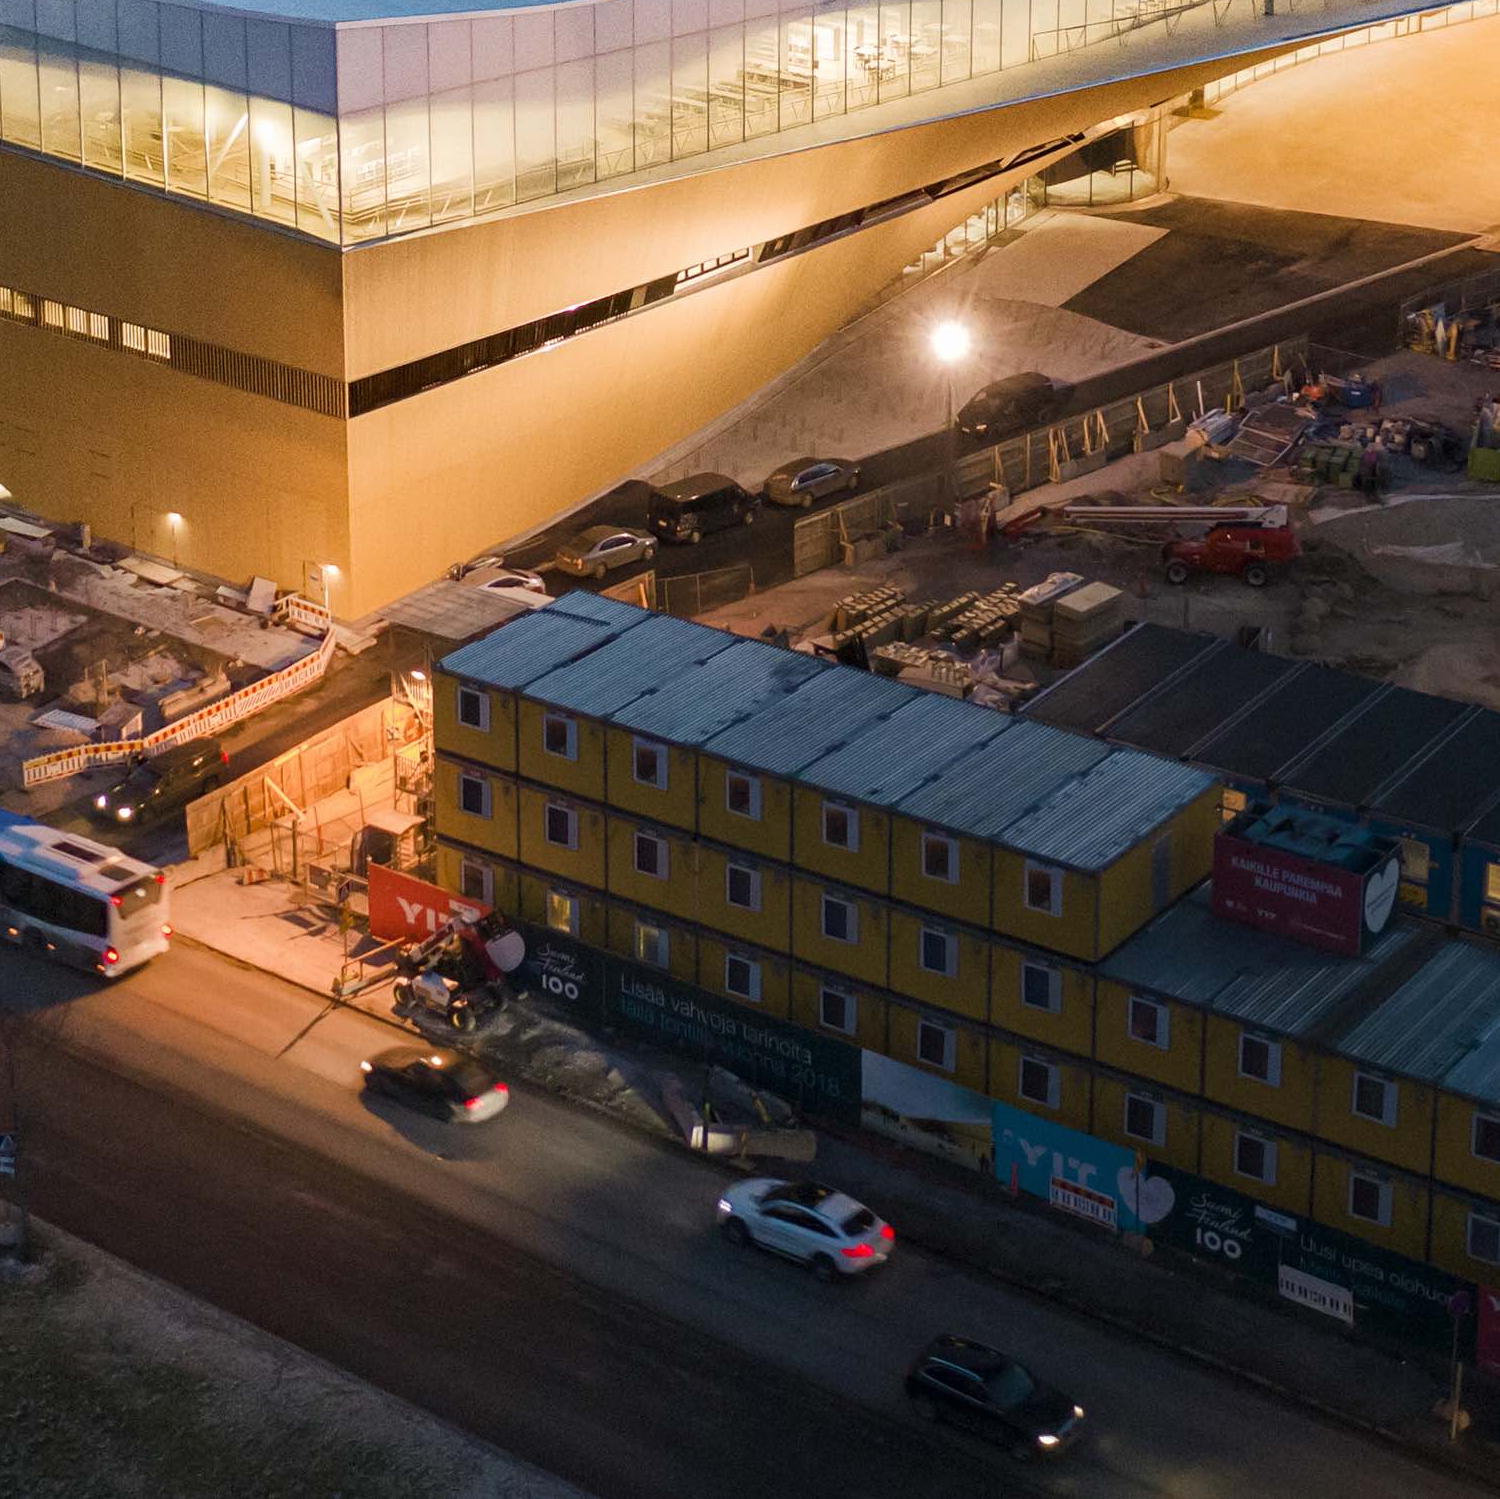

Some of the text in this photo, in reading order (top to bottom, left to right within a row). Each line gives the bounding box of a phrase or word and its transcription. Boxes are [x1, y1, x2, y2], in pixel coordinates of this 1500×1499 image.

[1231, 855, 1343, 899] KAIKILLE PAREMPAA
[1253, 876, 1318, 905] KAUPUNKIA
[541, 973, 580, 1001] 100
[742, 1023, 812, 1066] tarinoita
[791, 1062, 841, 1098] 2018
[1018, 1136, 1098, 1187] YIT
[1189, 1192, 1244, 1221] Suomi
[1186, 1207, 1253, 1242] Finland
[1195, 1228, 1243, 1260] 100
[1299, 1233, 1337, 1262] Uusi
[1341, 1254, 1385, 1282] upea
